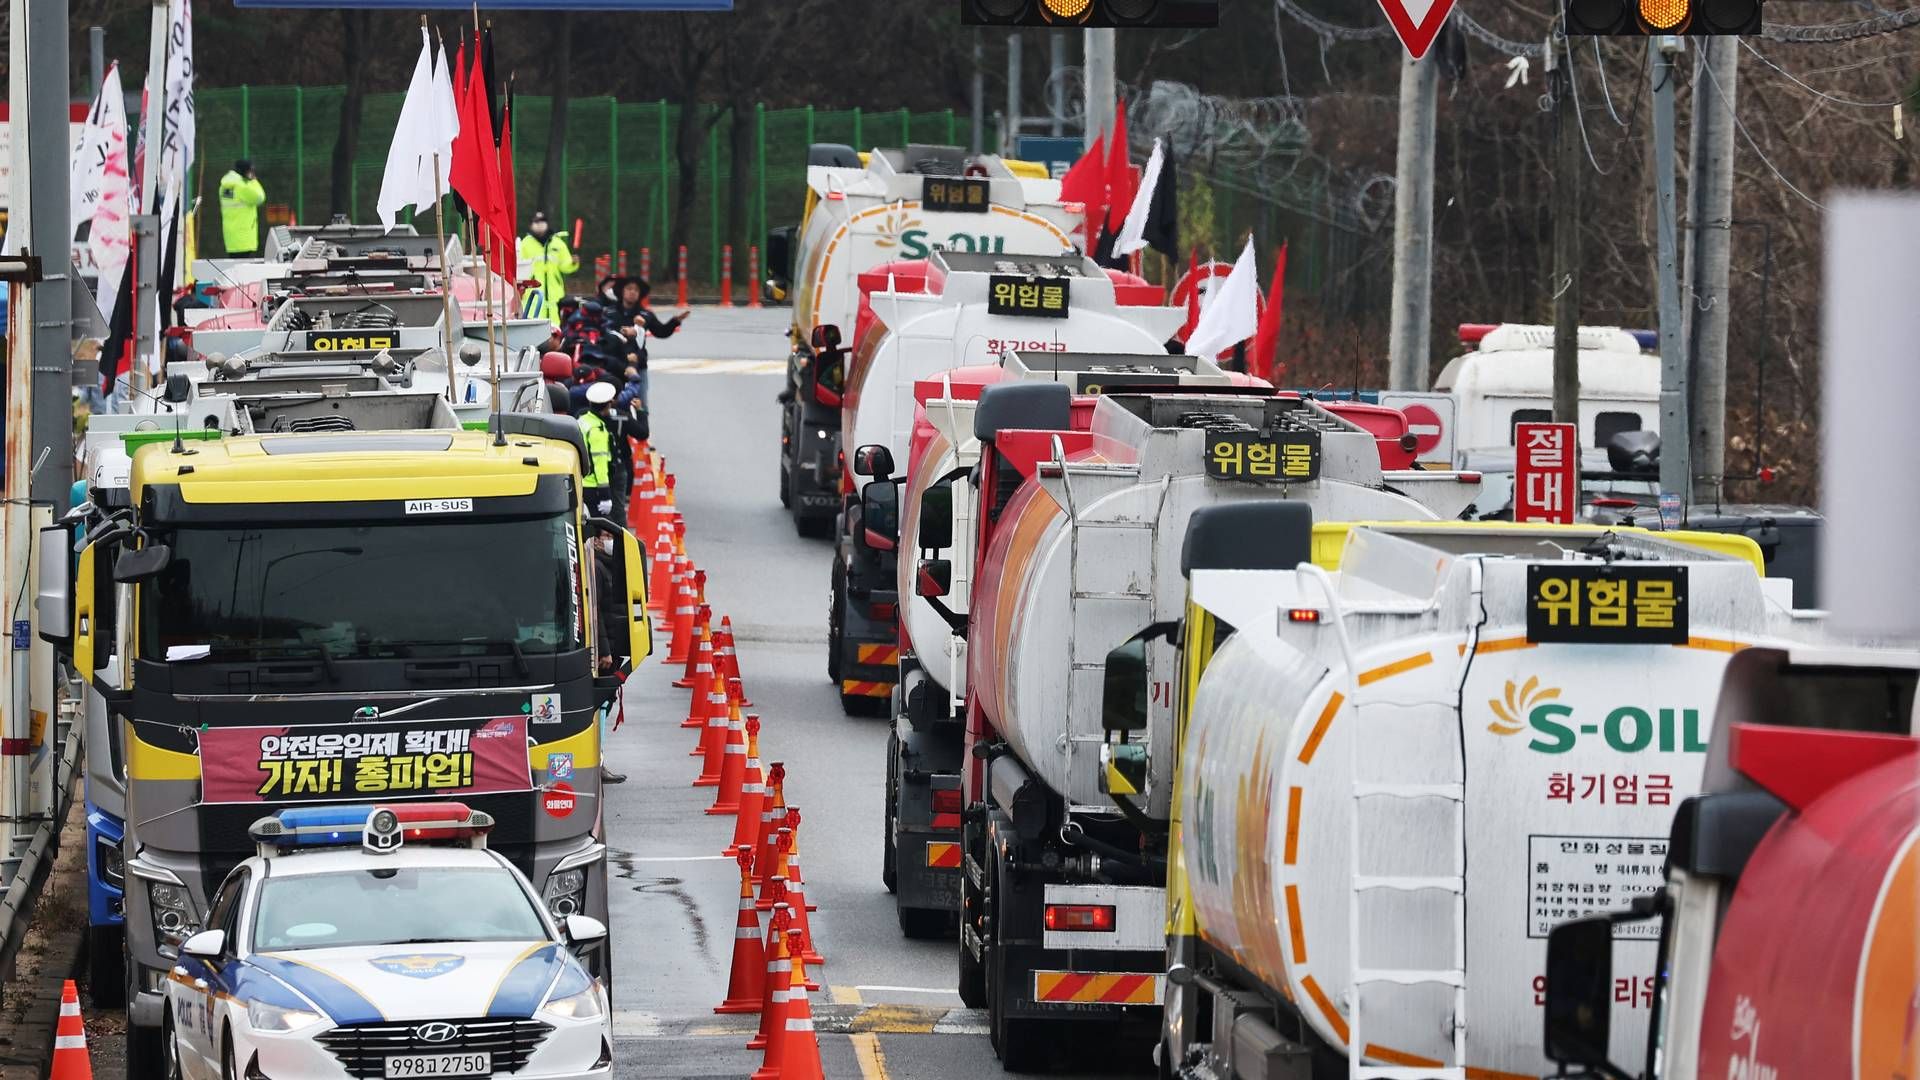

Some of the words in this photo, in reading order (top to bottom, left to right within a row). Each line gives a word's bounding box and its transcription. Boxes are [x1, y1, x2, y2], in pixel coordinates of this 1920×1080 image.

[994, 283, 1063, 310] 위험물
[1213, 441, 1312, 476] 위험물
[409, 500, 469, 512] AIR-SUS
[1537, 577, 1677, 628] 위험물
[260, 733, 399, 760] 안전운임제
[405, 729, 471, 755] 확대!
[1528, 703, 1709, 754] S-OIL
[258, 759, 342, 795] 가자!
[355, 753, 473, 792] 총파업!
[1546, 772, 1674, 806] 화기엄금
[392, 1057, 437, 1075] 998고
[441, 1055, 485, 1073] 2750
